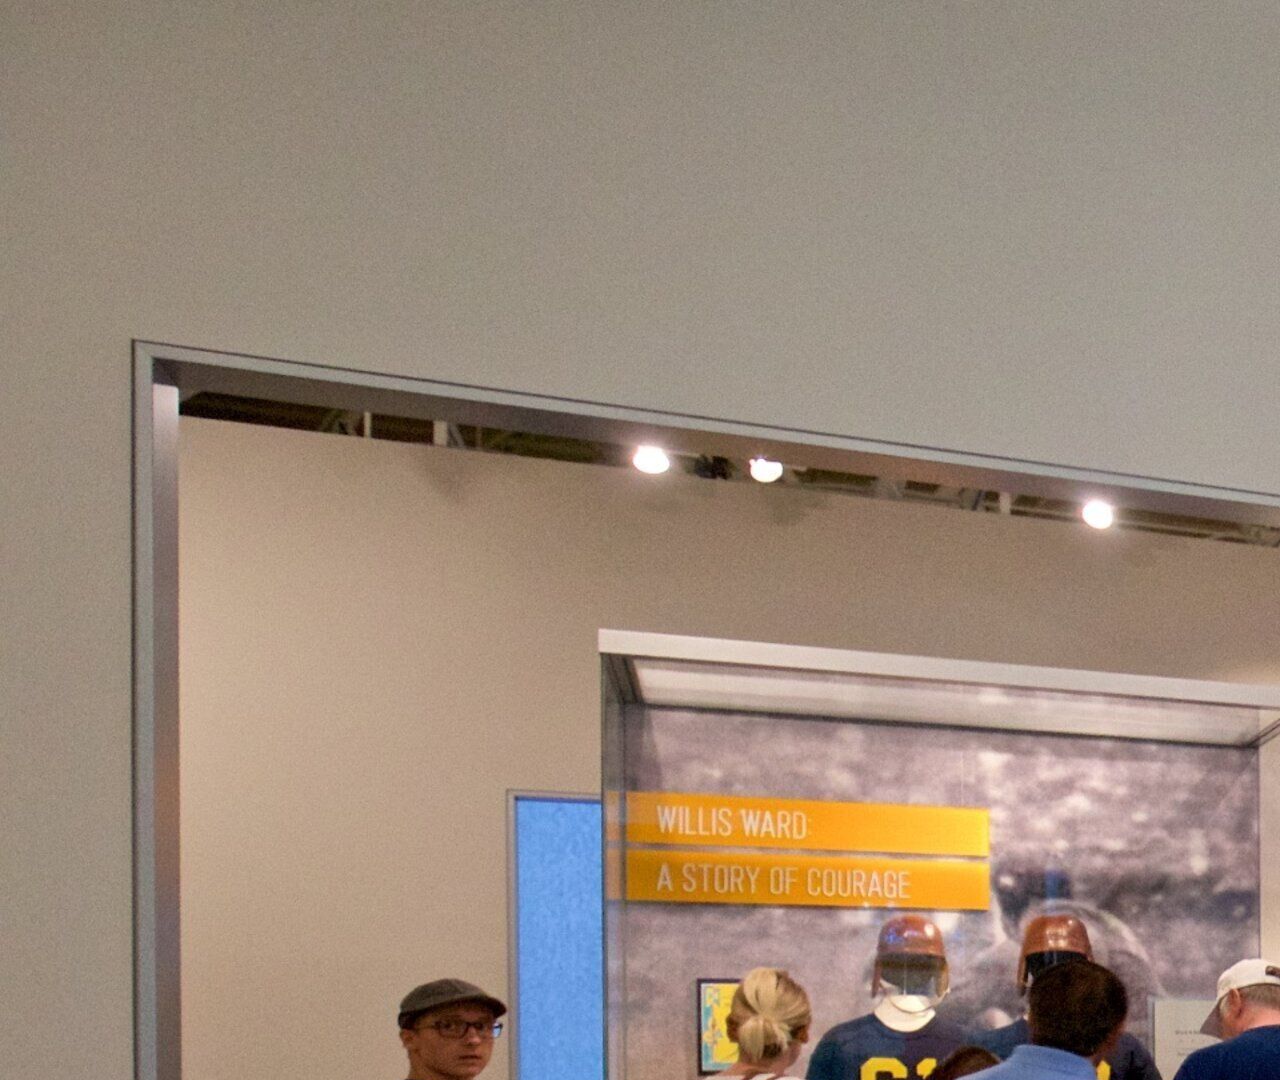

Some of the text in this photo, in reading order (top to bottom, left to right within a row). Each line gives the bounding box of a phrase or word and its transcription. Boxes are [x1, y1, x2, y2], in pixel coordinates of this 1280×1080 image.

[657, 805, 733, 837] WILLIS
[656, 864, 911, 899] A STORY OF COURAGE
